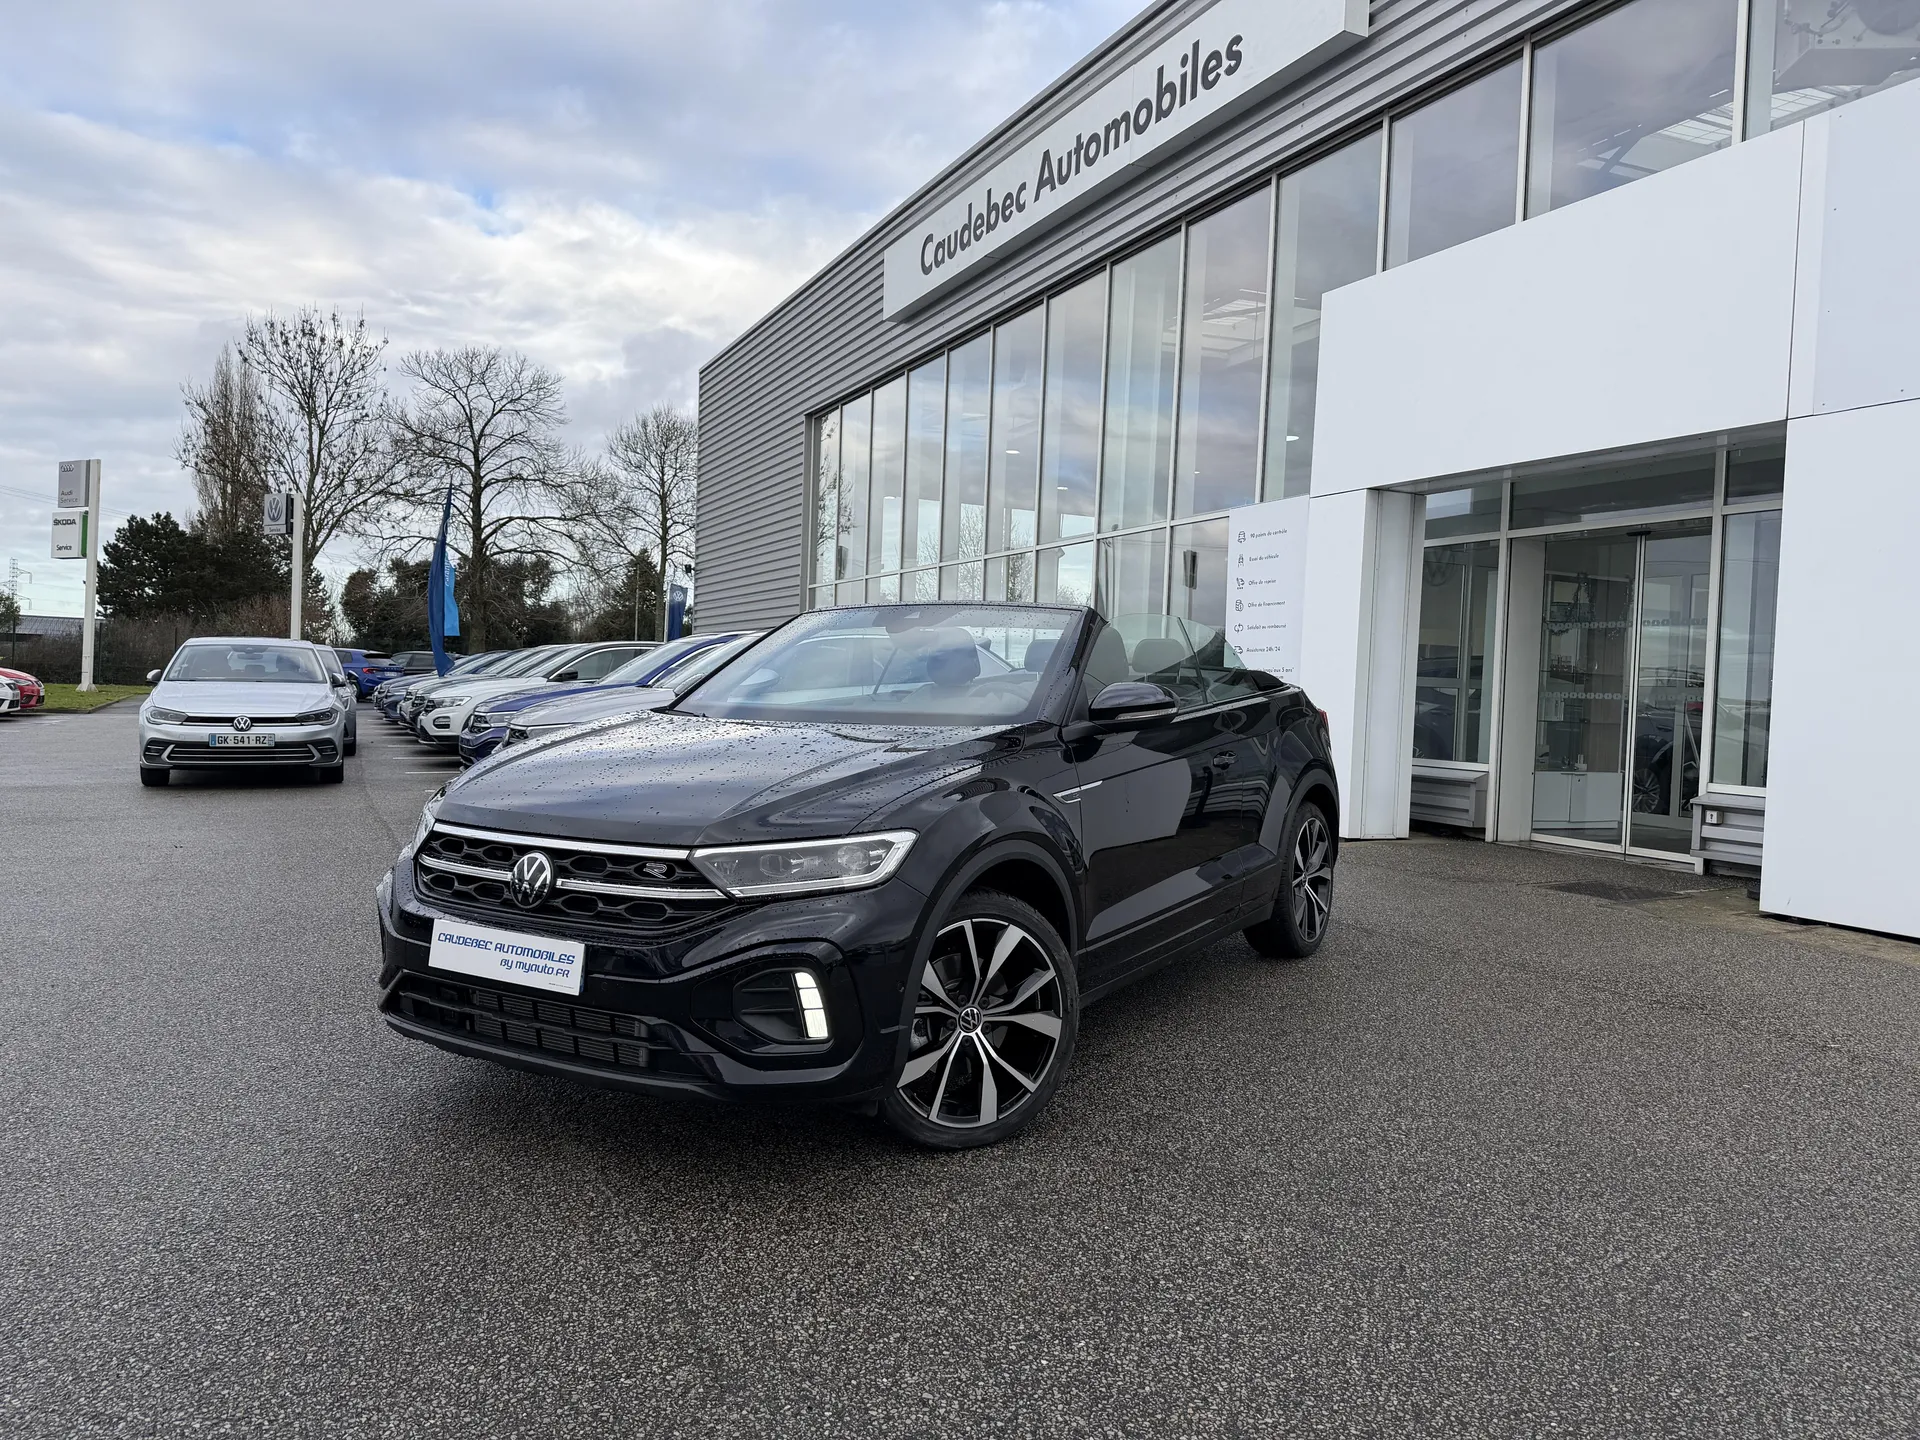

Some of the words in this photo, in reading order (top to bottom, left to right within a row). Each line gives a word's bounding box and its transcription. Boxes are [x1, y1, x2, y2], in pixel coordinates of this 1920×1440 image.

[920, 181, 1027, 276] Caudebec
[1033, 33, 1244, 204] Automobiles
[437, 932, 492, 951] CAUDEBEC
[494, 942, 575, 965] AUTOMOBILES
